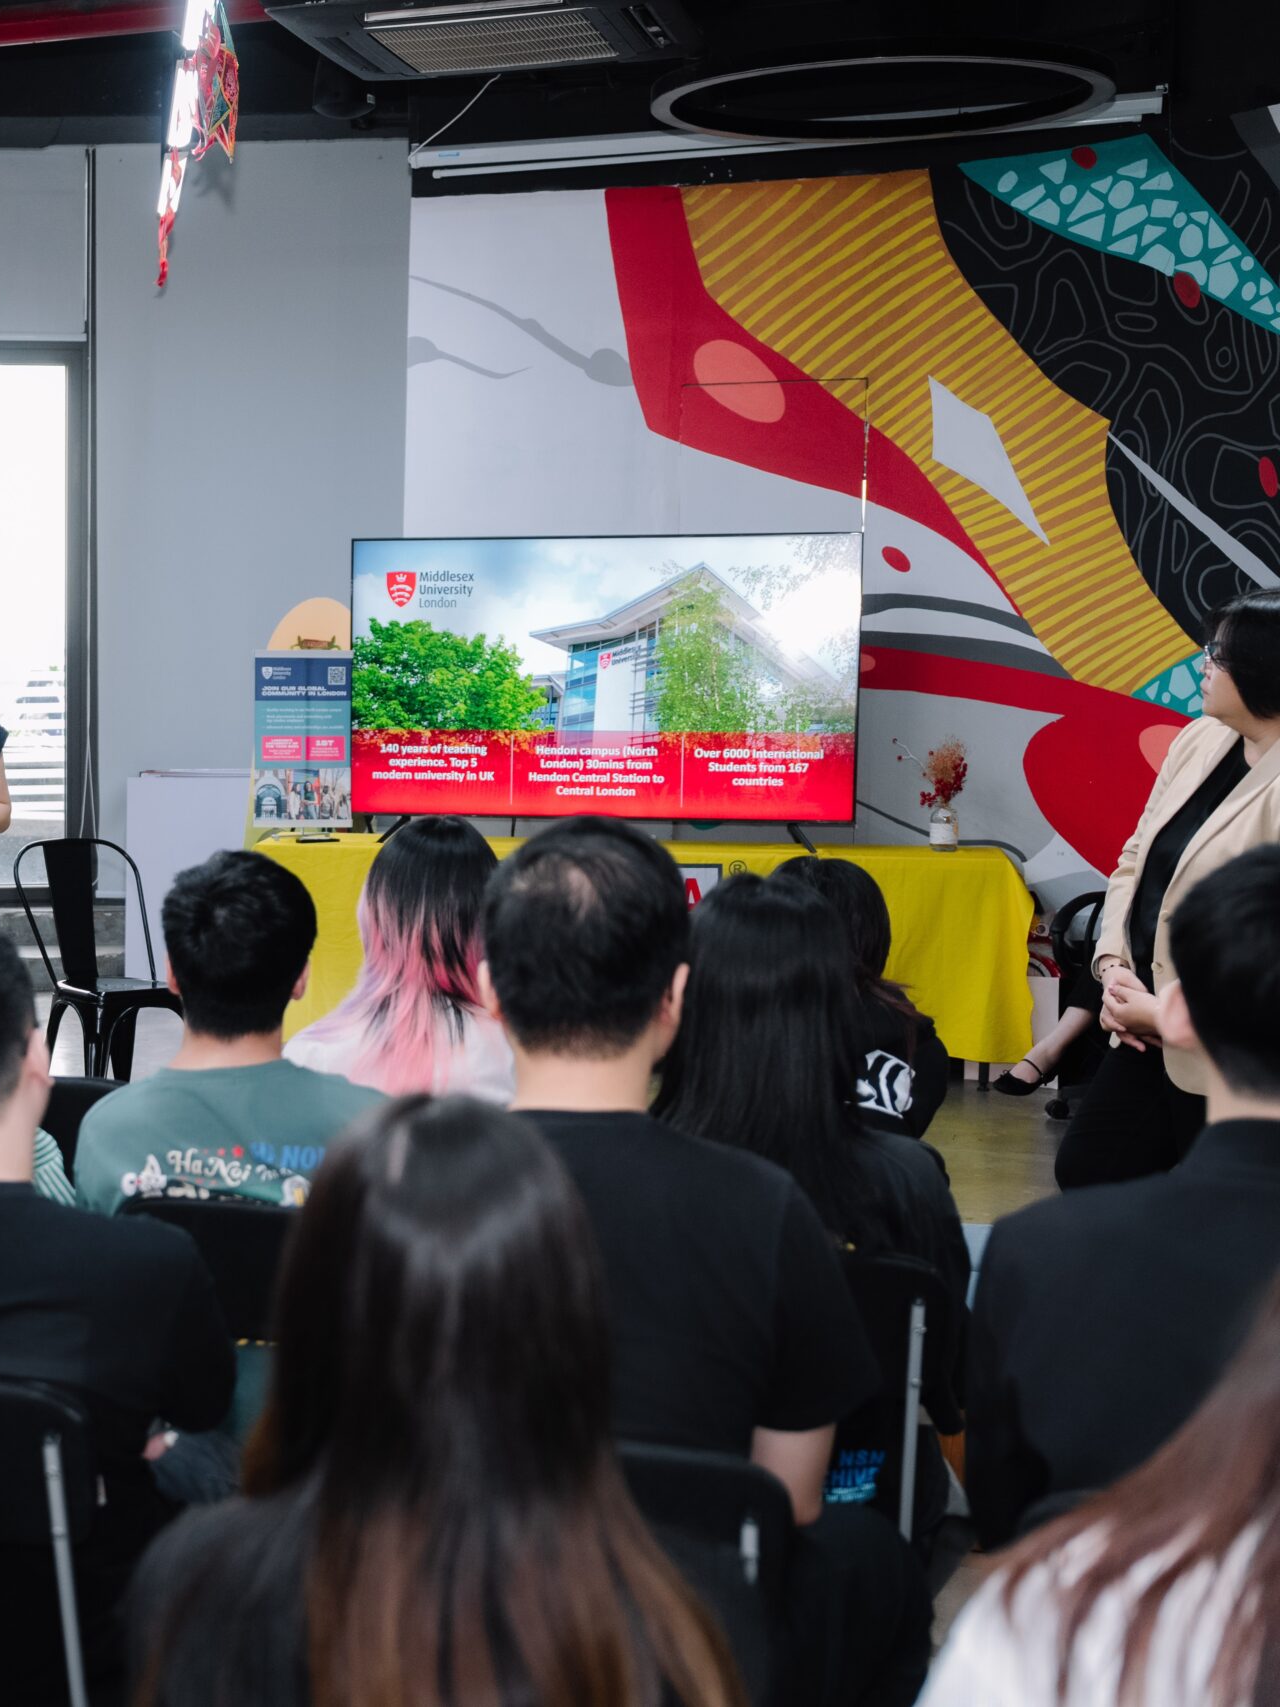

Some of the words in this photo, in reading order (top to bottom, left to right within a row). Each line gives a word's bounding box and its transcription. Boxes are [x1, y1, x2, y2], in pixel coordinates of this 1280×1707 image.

[419, 571, 475, 583] Middlesex
[419, 584, 474, 597] University
[419, 598, 457, 608] London
[380, 744, 399, 754] 140
[401, 745, 428, 756] years
[429, 743, 442, 754] of
[443, 744, 487, 756] teaching
[536, 745, 577, 755] Hendon
[580, 747, 620, 758] campus
[623, 746, 658, 757] (North
[694, 748, 721, 758] Over
[723, 748, 750, 759] 6000
[752, 748, 824, 760] International
[389, 757, 448, 768] experience.
[450, 757, 469, 768] Top
[470, 758, 478, 767] 5
[540, 759, 584, 770] London)
[586, 759, 625, 769] 30mins
[626, 759, 653, 770] from
[708, 762, 757, 772] Students
[758, 762, 786, 773] from
[788, 763, 809, 773] 167
[372, 771, 412, 780] modern
[414, 771, 464, 782] university
[466, 771, 477, 781] in
[479, 771, 495, 781] UK
[528, 772, 570, 782] Hendon
[571, 772, 610, 782] Central
[612, 773, 651, 783] Station
[652, 774, 665, 783] to
[732, 777, 784, 786] countries
[556, 786, 594, 796] Central
[596, 786, 636, 796] London
[828, 1467, 880, 1488] HIVE
